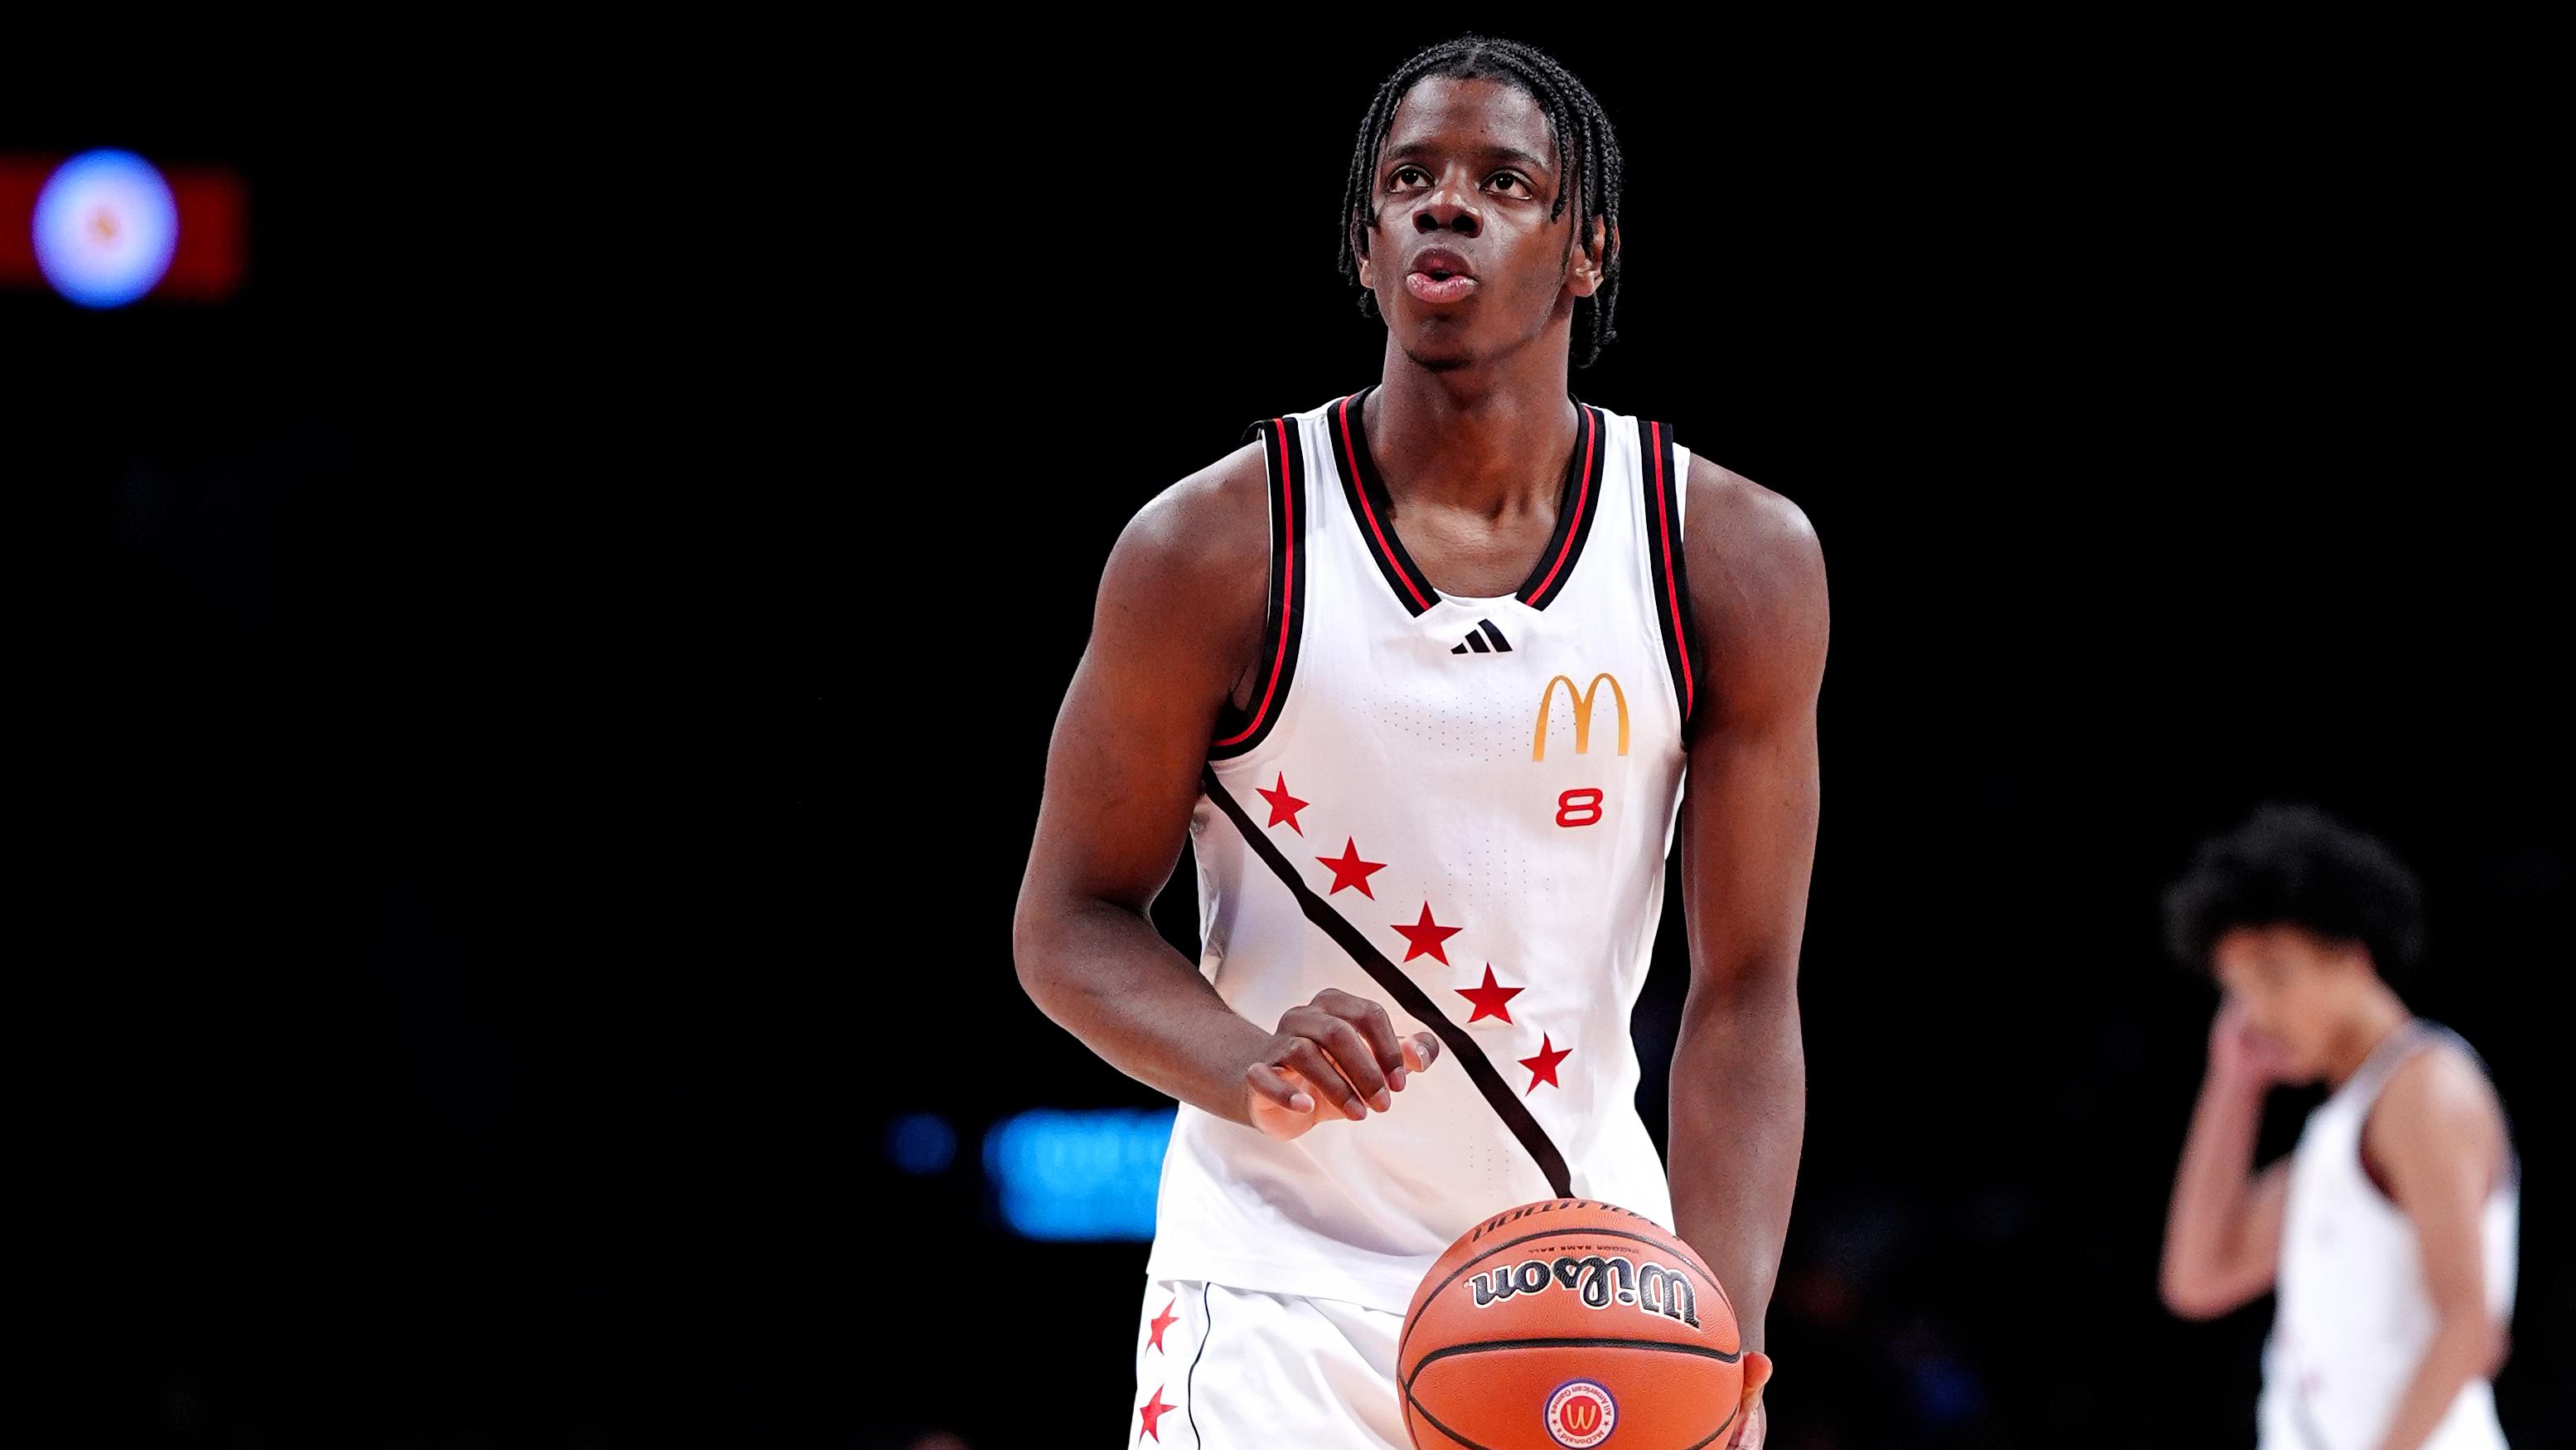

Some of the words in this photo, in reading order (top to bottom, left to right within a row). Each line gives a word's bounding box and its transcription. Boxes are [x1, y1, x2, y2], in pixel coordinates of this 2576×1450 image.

[1556, 788, 1604, 827] 8
[1470, 1255, 1701, 1331] Wilson
[1551, 1389, 1571, 1414] Games
[1571, 1385, 1610, 1404] American
[1603, 1404, 1612, 1417] All
[1557, 1428, 1605, 1444] McDonald's
